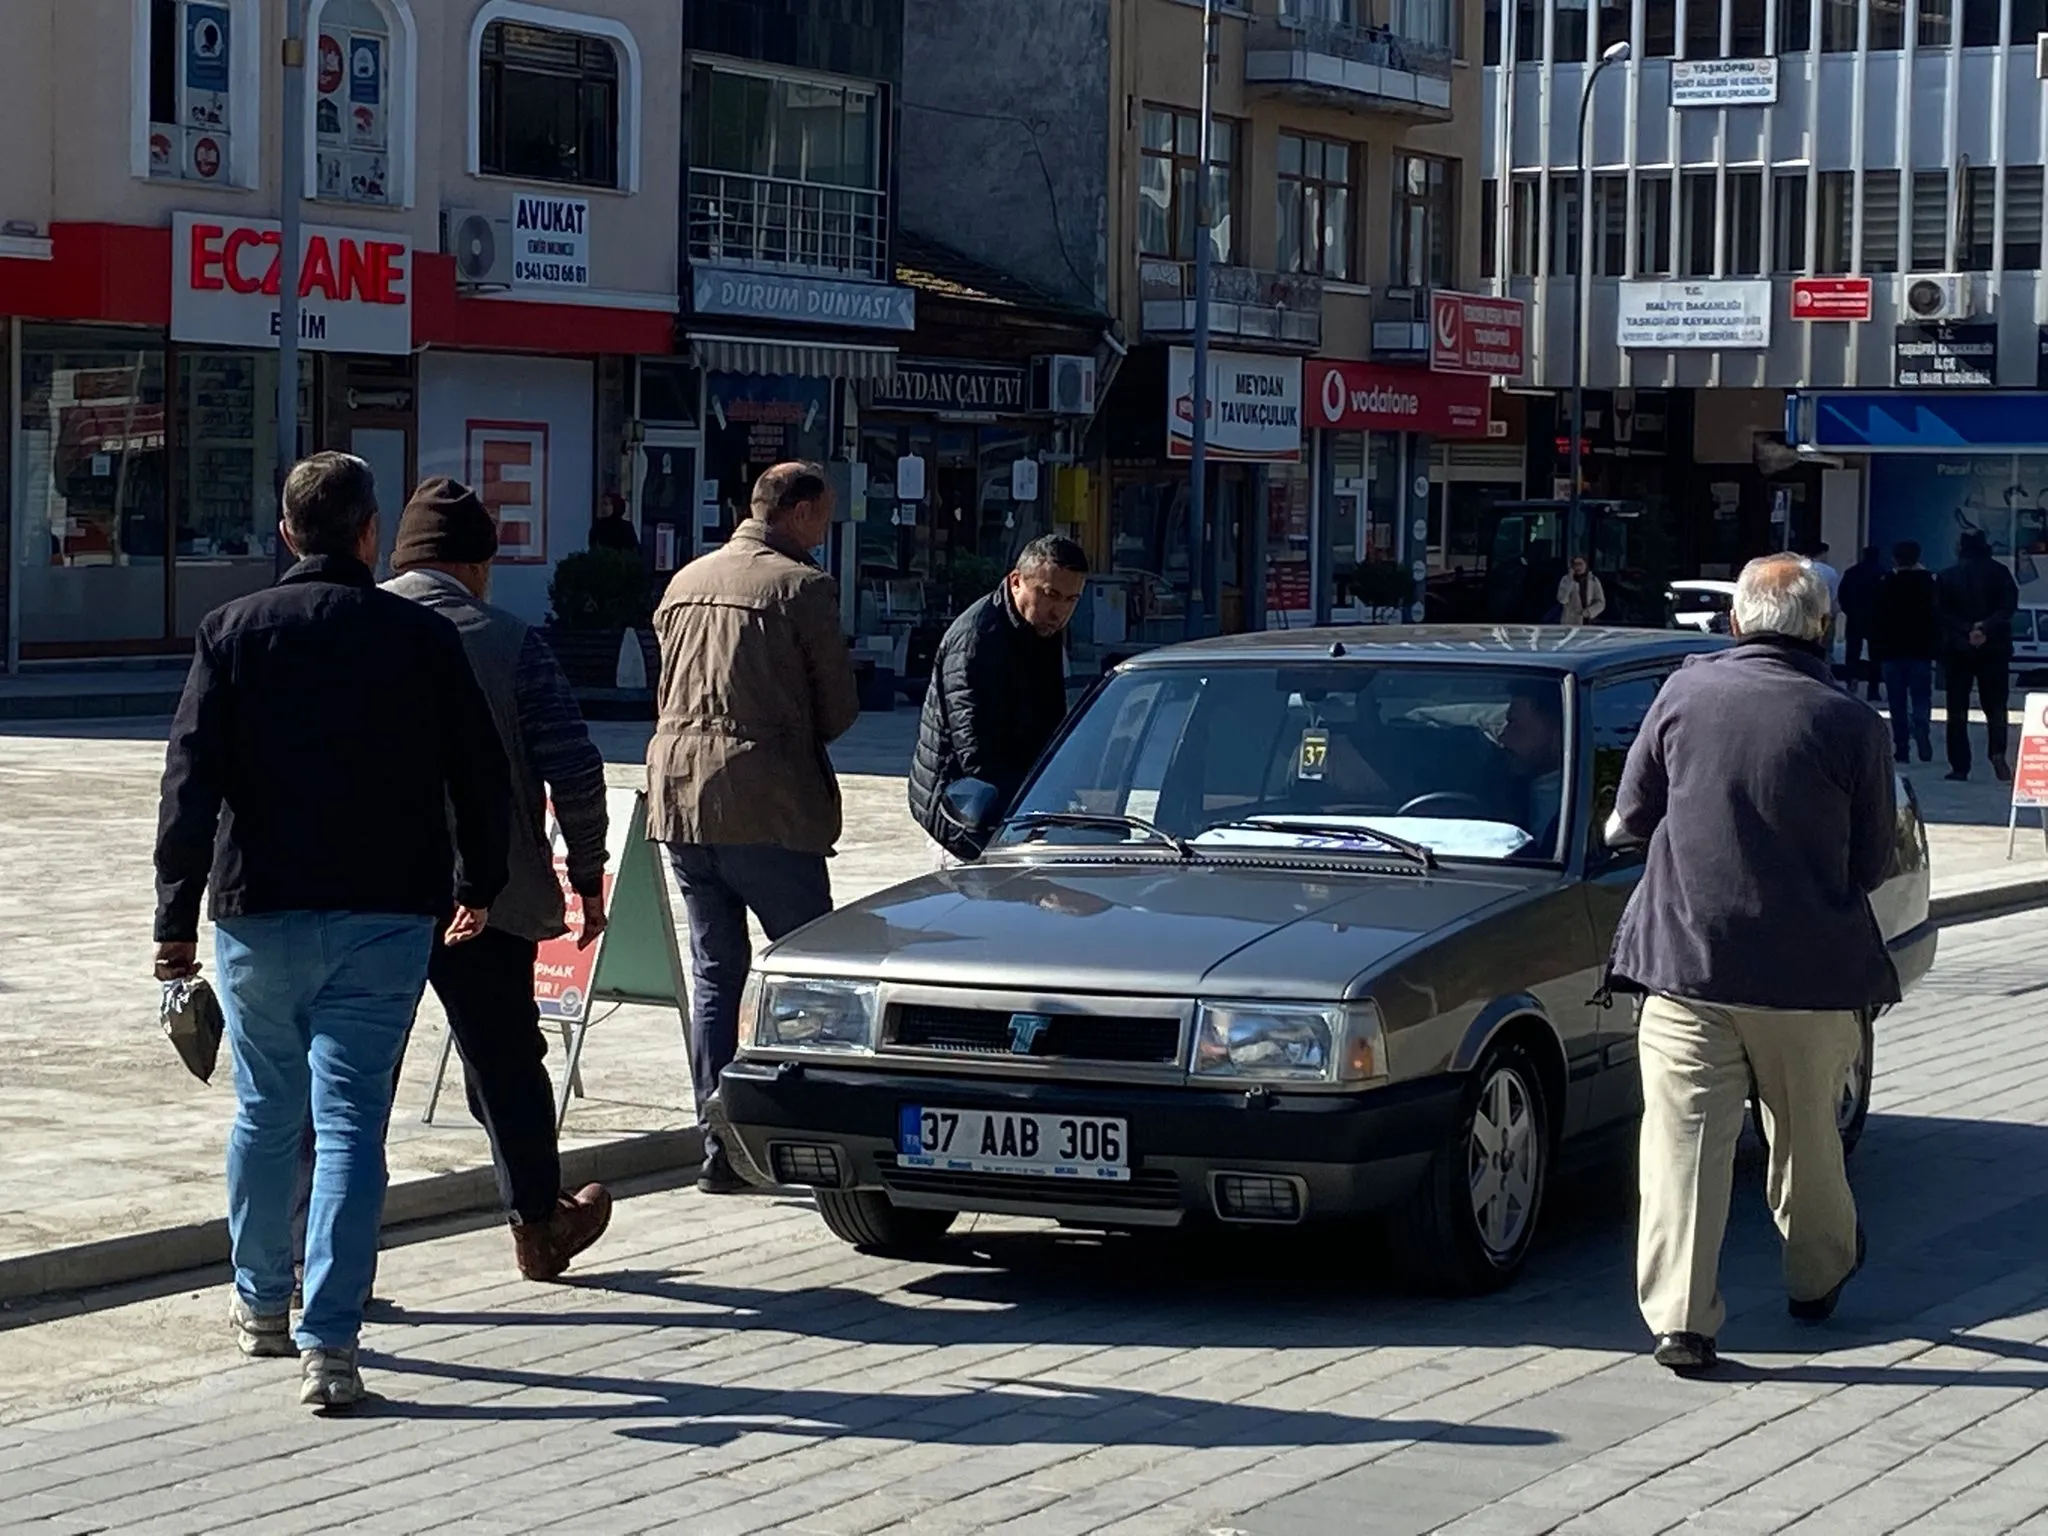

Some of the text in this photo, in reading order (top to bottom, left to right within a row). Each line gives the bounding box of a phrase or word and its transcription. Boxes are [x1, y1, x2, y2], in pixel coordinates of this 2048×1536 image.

[516, 199, 587, 234] AVUKAT
[191, 224, 406, 305] ECZANE
[515, 261, 523, 279] 0
[270, 308, 326, 340] EİM
[1235, 373, 1284, 397] MEYDAN
[1350, 384, 1419, 415] vodafone
[1221, 401, 1297, 431] TAVUKÇULUK
[1303, 745, 1327, 767] 37
[533, 962, 576, 980] PMAK
[921, 1112, 1121, 1162] 37 AAB 306
